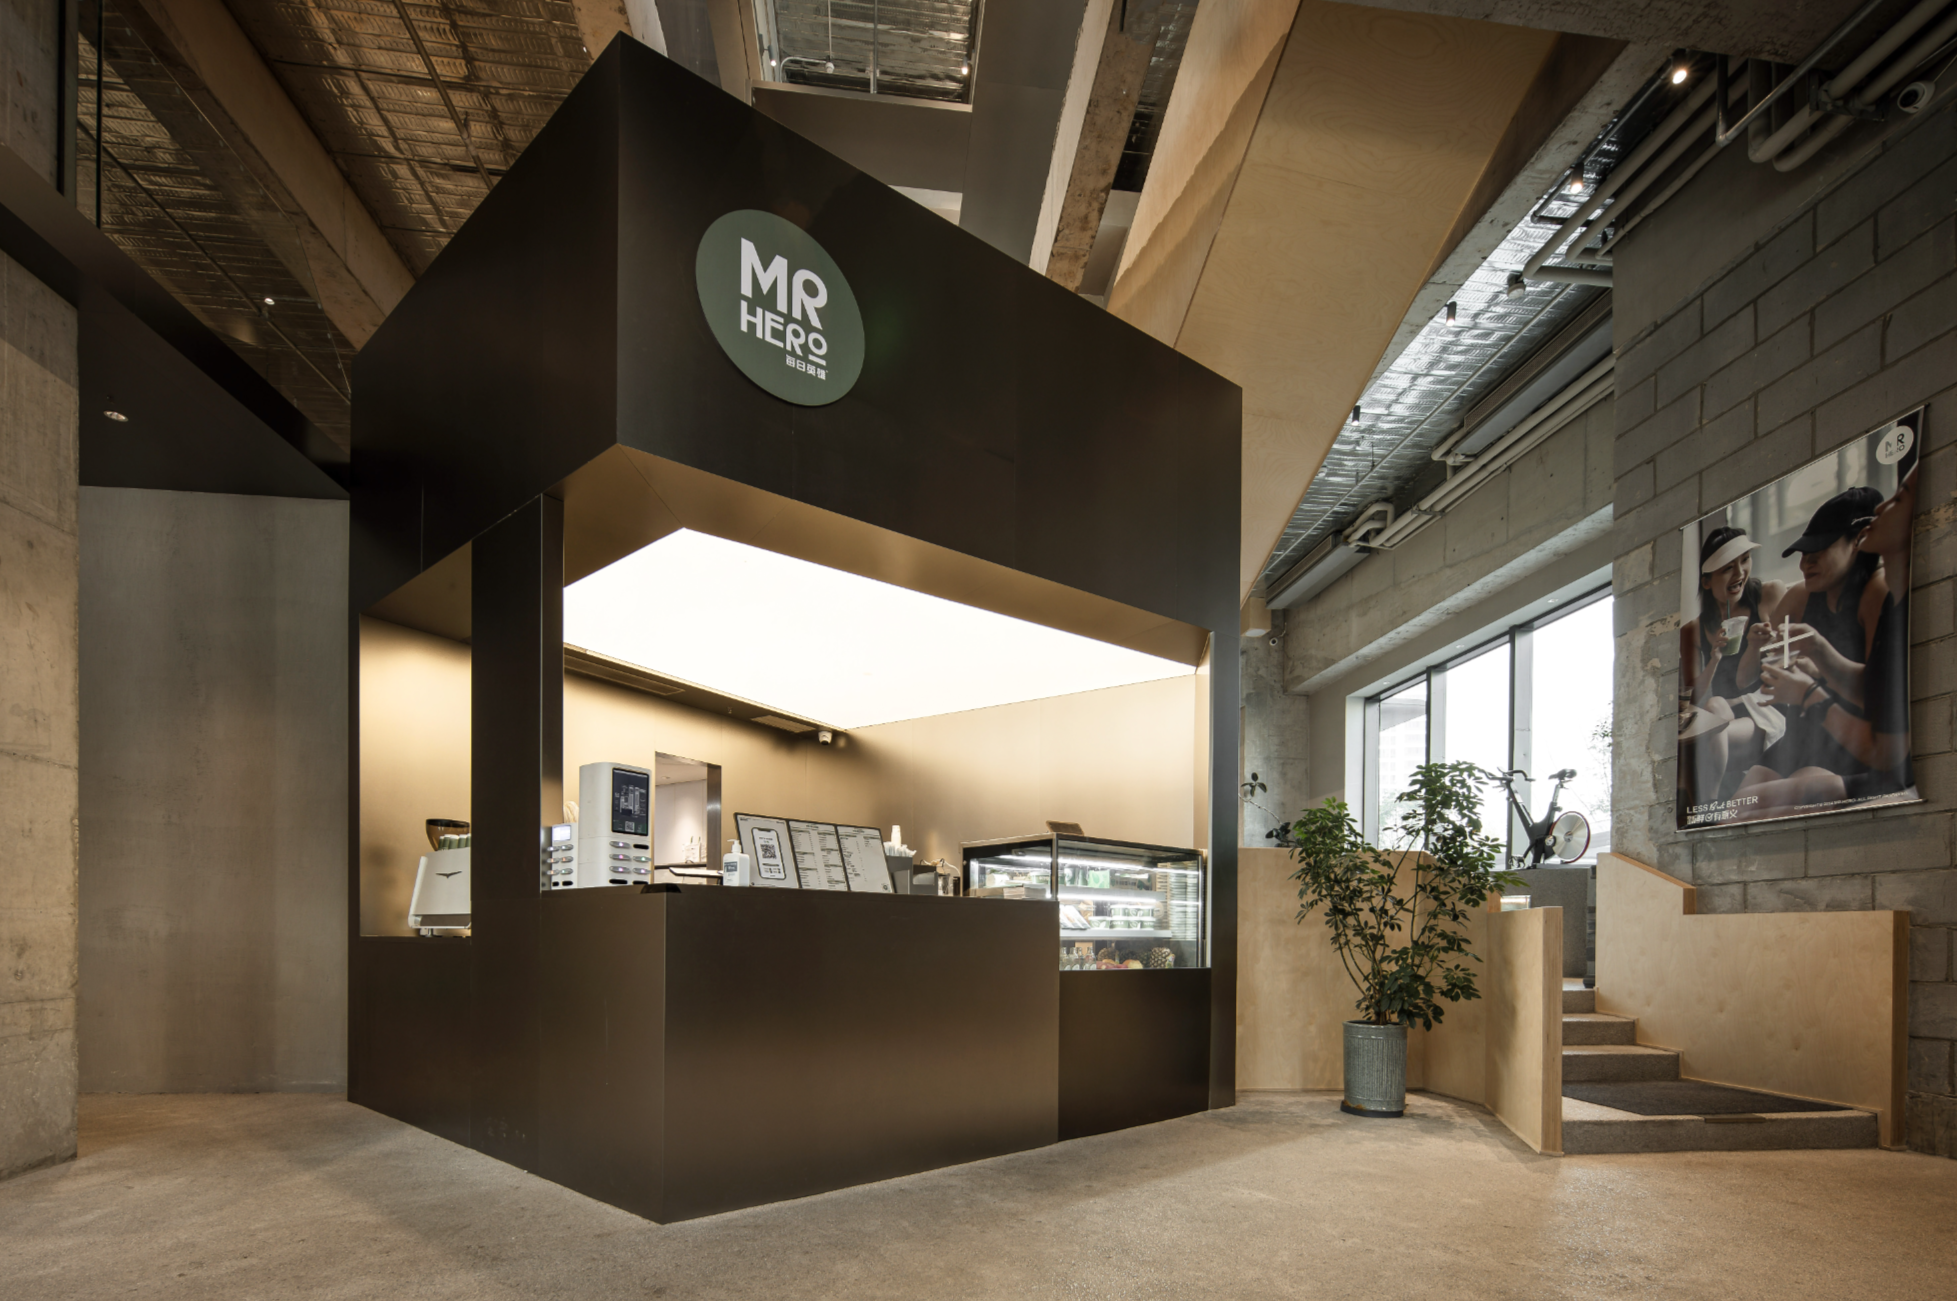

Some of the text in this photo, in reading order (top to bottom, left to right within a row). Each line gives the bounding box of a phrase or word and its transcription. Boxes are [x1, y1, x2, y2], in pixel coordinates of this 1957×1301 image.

[740, 237, 828, 330] MR
[740, 299, 828, 366] HERO
[785, 354, 826, 381] 每日英雄
[1686, 805, 1708, 814] LESS
[1726, 795, 1759, 808] BETTER
